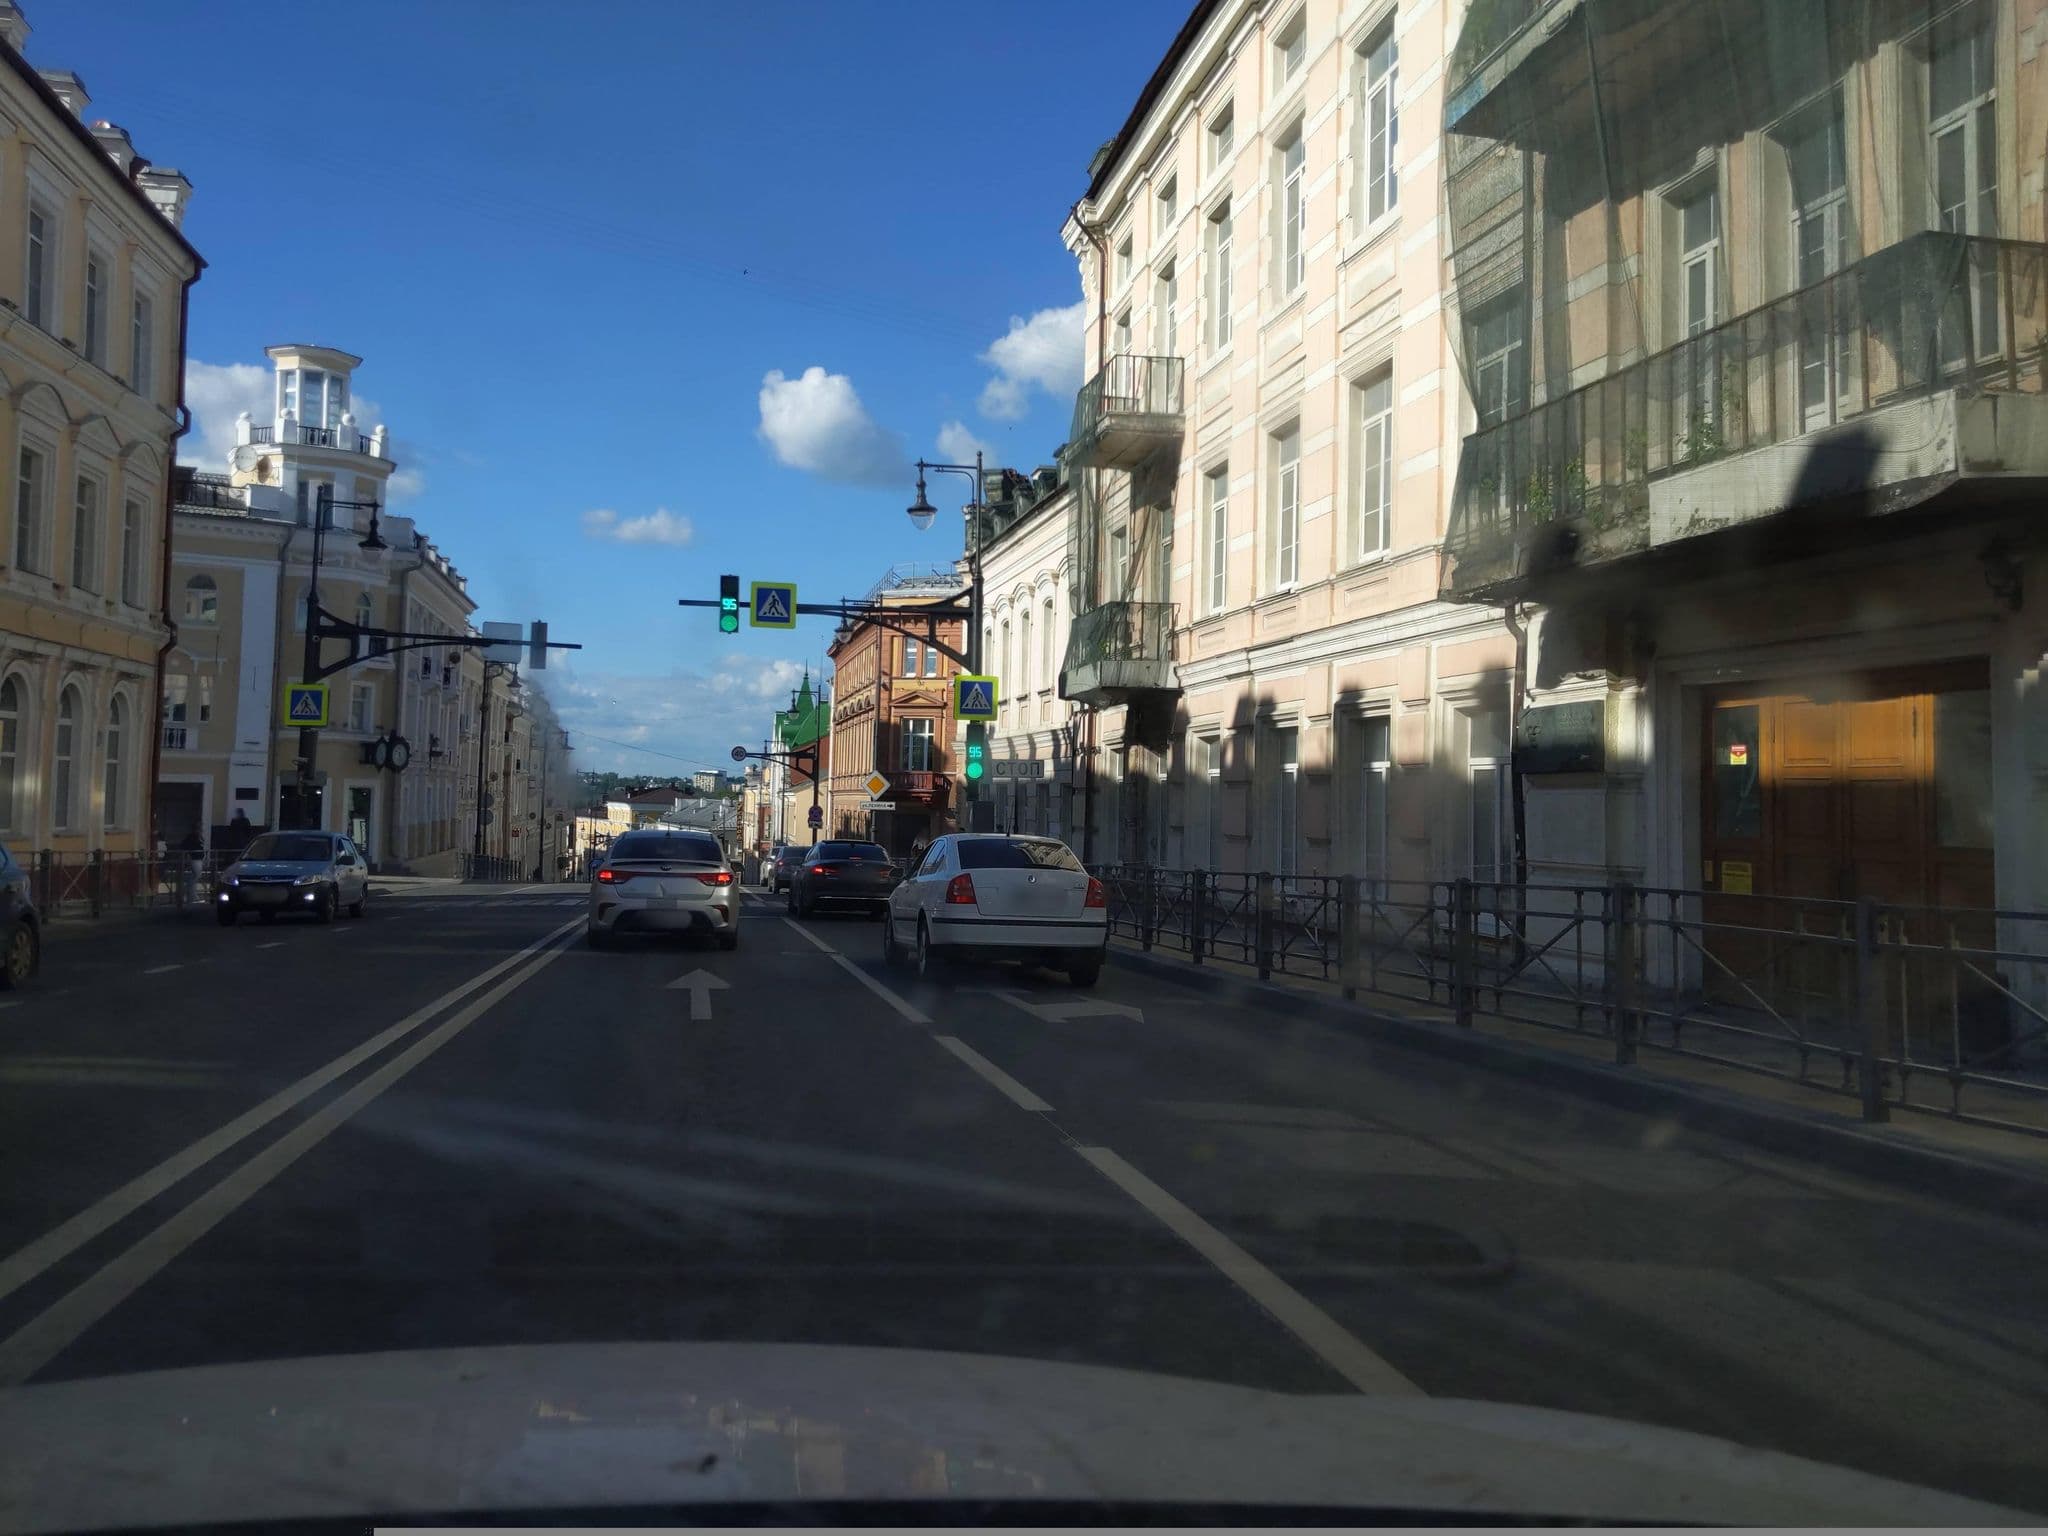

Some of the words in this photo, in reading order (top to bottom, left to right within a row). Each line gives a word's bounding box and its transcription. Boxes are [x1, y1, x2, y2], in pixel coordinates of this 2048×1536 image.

[722, 598, 737, 610] 95
[969, 746, 982, 758] 95
[996, 761, 1040, 776] СТОП
